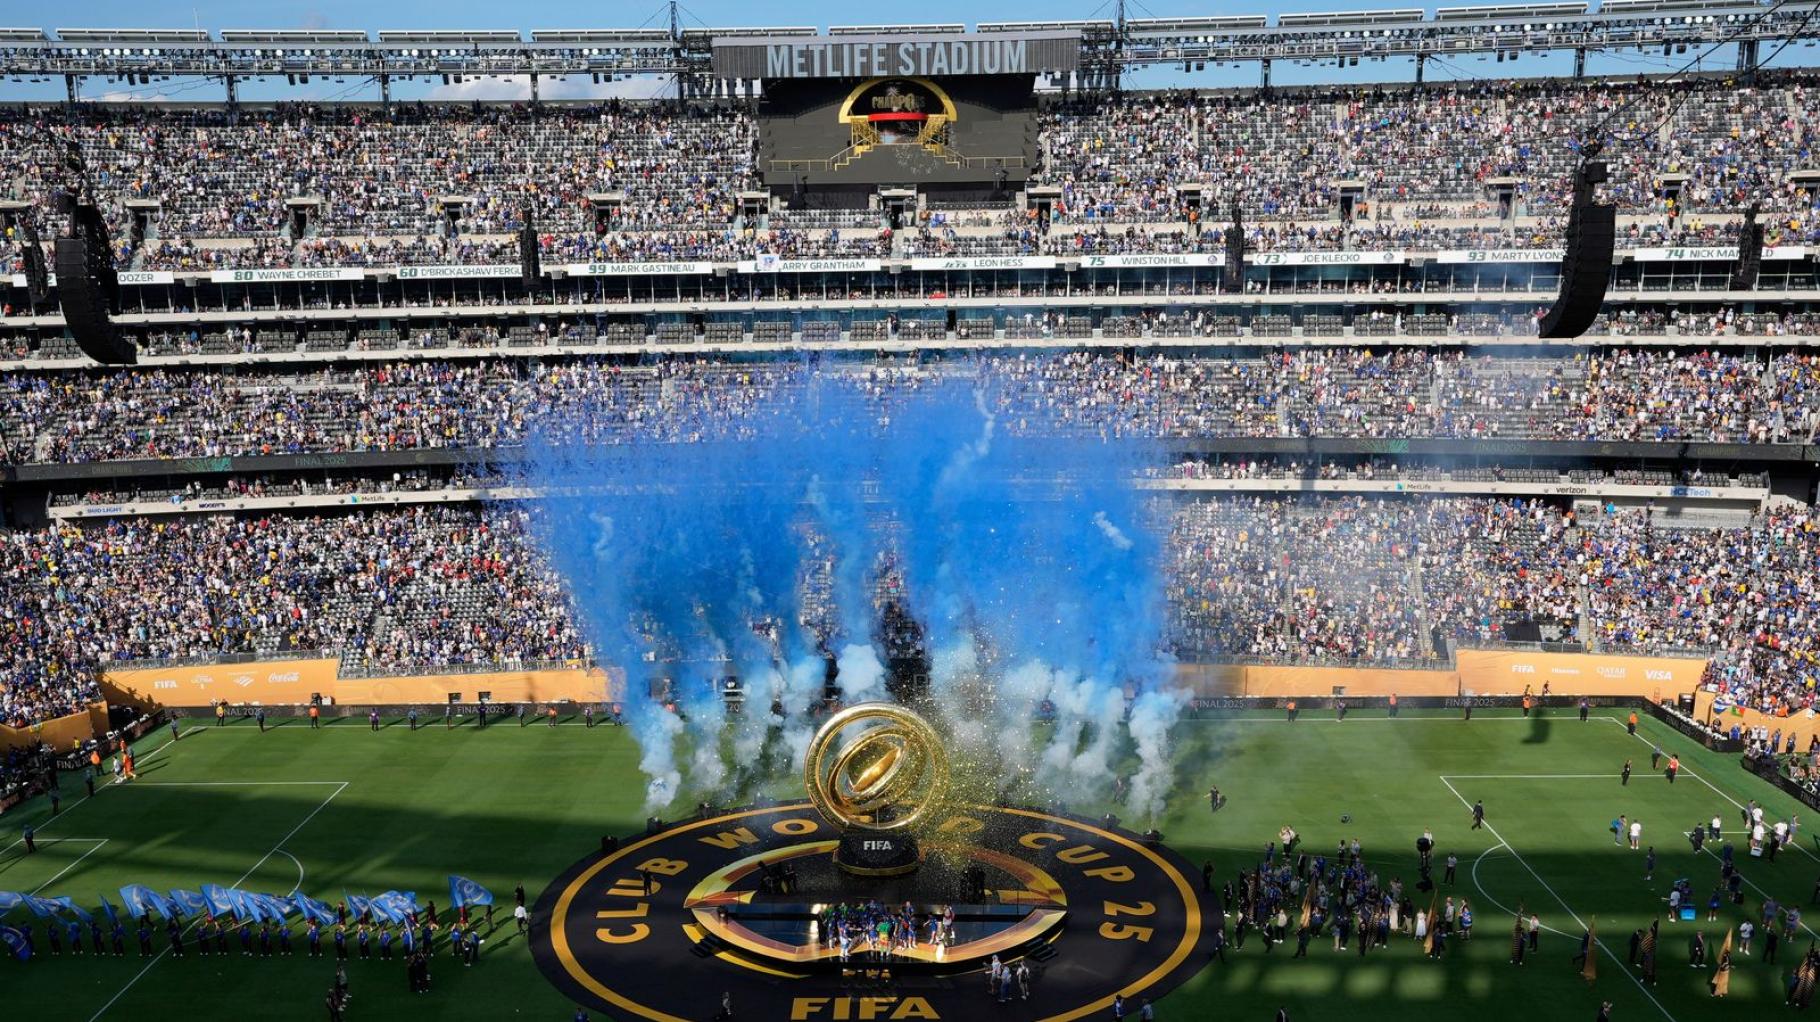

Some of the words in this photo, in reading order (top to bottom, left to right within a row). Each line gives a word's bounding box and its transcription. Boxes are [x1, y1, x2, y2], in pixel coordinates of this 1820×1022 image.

[766, 43, 888, 78] METLIFE
[899, 40, 1026, 76] STADIUM
[1263, 254, 1280, 264] 73
[1301, 254, 1320, 263] JOE
[1321, 253, 1360, 263] KLECKO
[1468, 251, 1487, 261] 93
[1491, 251, 1531, 260] MARTY
[1664, 249, 1685, 259] 74
[1689, 248, 1714, 258] NICK
[778, 261, 807, 271] ARRY
[809, 261, 866, 271] GRANTHAM
[974, 259, 998, 267] LEON
[999, 258, 1024, 267] HESS
[1088, 256, 1105, 266] 75
[1121, 256, 1165, 265] WINSTON
[1166, 256, 1189, 265] HILL
[400, 267, 418, 277] 60
[420, 267, 492, 277] D'BRICKASHAW
[588, 264, 607, 274] 99
[610, 263, 641, 273] MARK
[642, 262, 696, 273] GASTINEAU
[118, 273, 154, 282] OOZER
[234, 271, 253, 281] 80
[257, 270, 295, 280] WAYNE
[297, 269, 342, 279] CHREBET
[1556, 486, 1587, 494] verizon
[1511, 664, 1535, 673] FIFA
[1645, 670, 1673, 681] VISA
[153, 680, 177, 689] FIFA
[456, 706, 480, 714] FINA
[863, 840, 893, 851] FIFA
[595, 857, 689, 945] CLUB
[1018, 832, 1136, 883] CUP
[1099, 900, 1157, 943] 25
[790, 996, 942, 1021] FIFA
